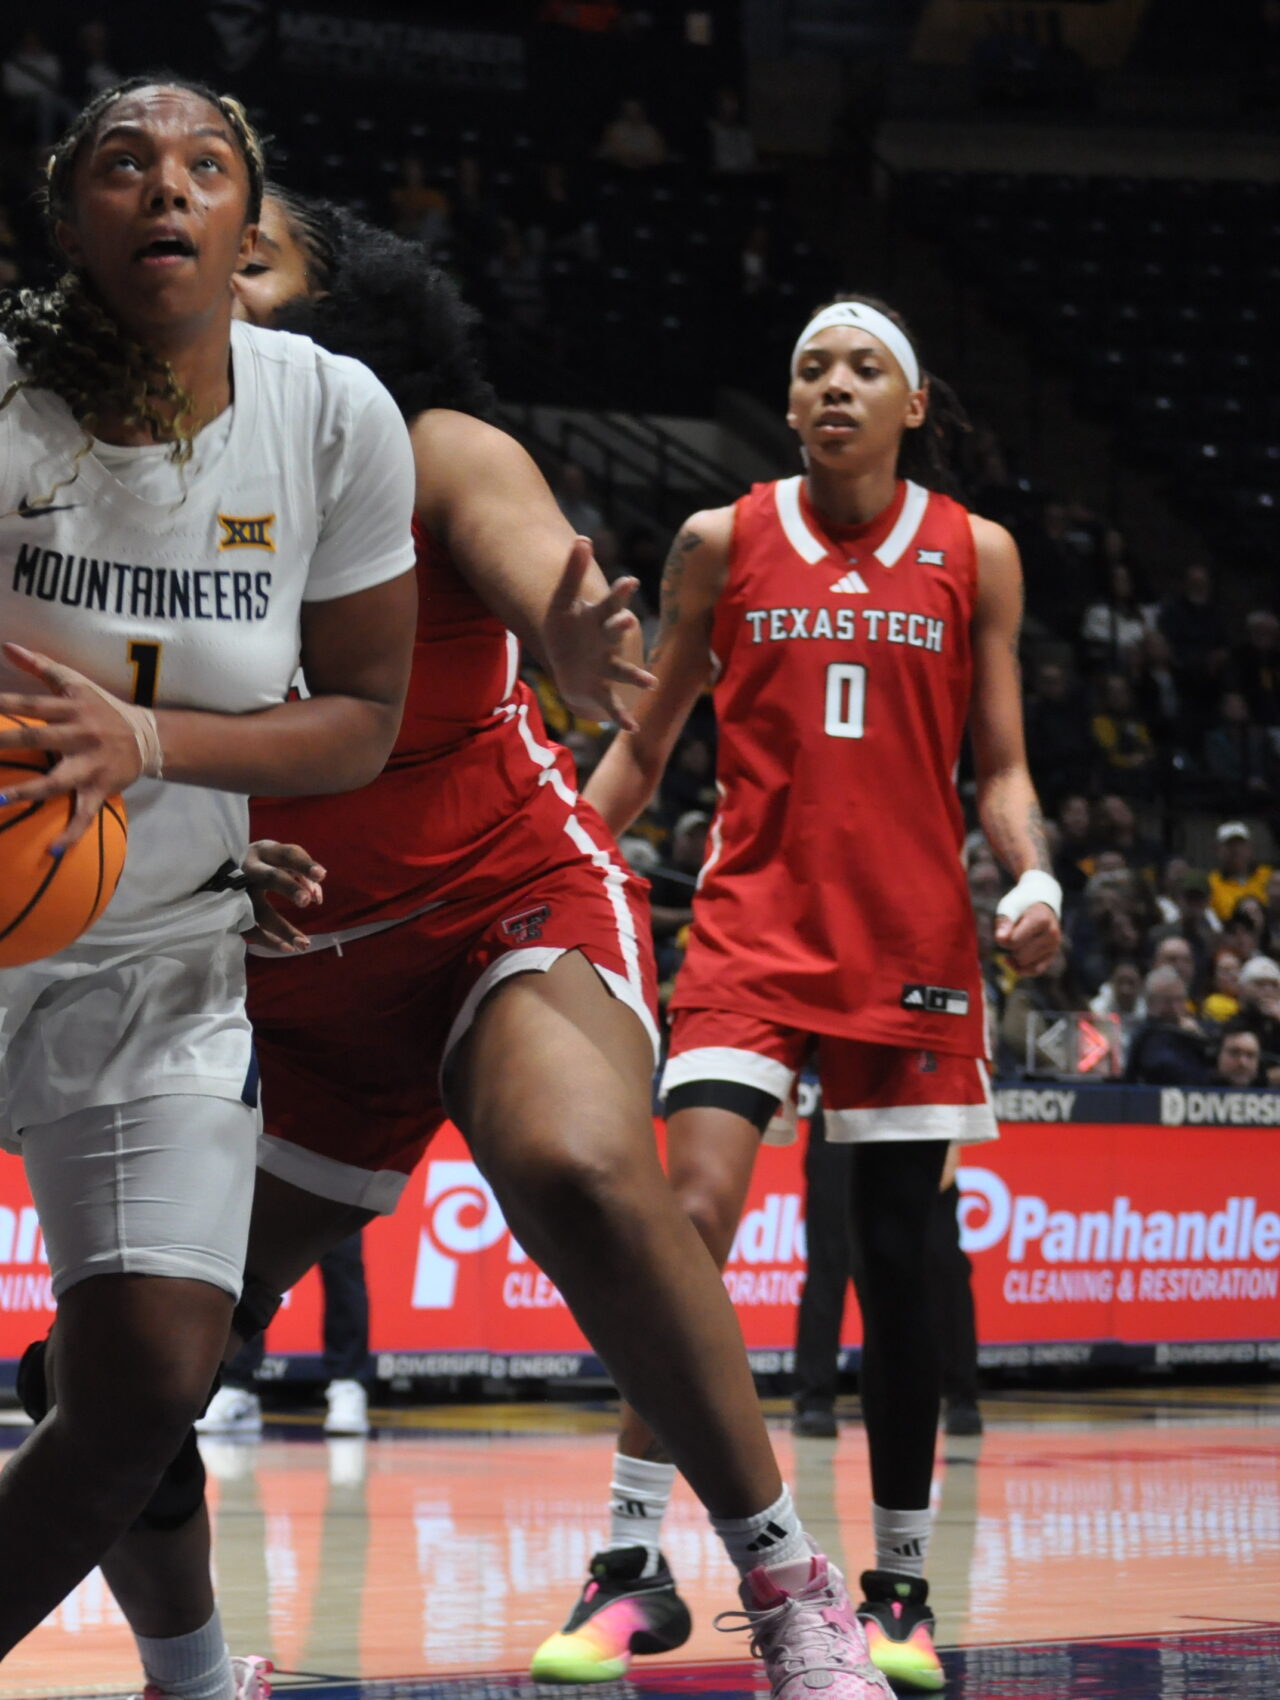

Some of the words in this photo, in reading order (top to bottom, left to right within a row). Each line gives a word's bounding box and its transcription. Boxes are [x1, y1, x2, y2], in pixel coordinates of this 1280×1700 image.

[12, 543, 272, 621] MOUNTAINEERS
[745, 607, 856, 643] TEXAS
[861, 609, 945, 653] TECH
[126, 638, 163, 708] 1
[824, 661, 867, 740] 0
[993, 1088, 1077, 1123] NERGY
[1187, 1091, 1280, 1125] DIVERSI
[1007, 1194, 1280, 1263] Panhandle
[1003, 1268, 1112, 1304] CLEANING
[1138, 1267, 1278, 1302] RESTORATION
